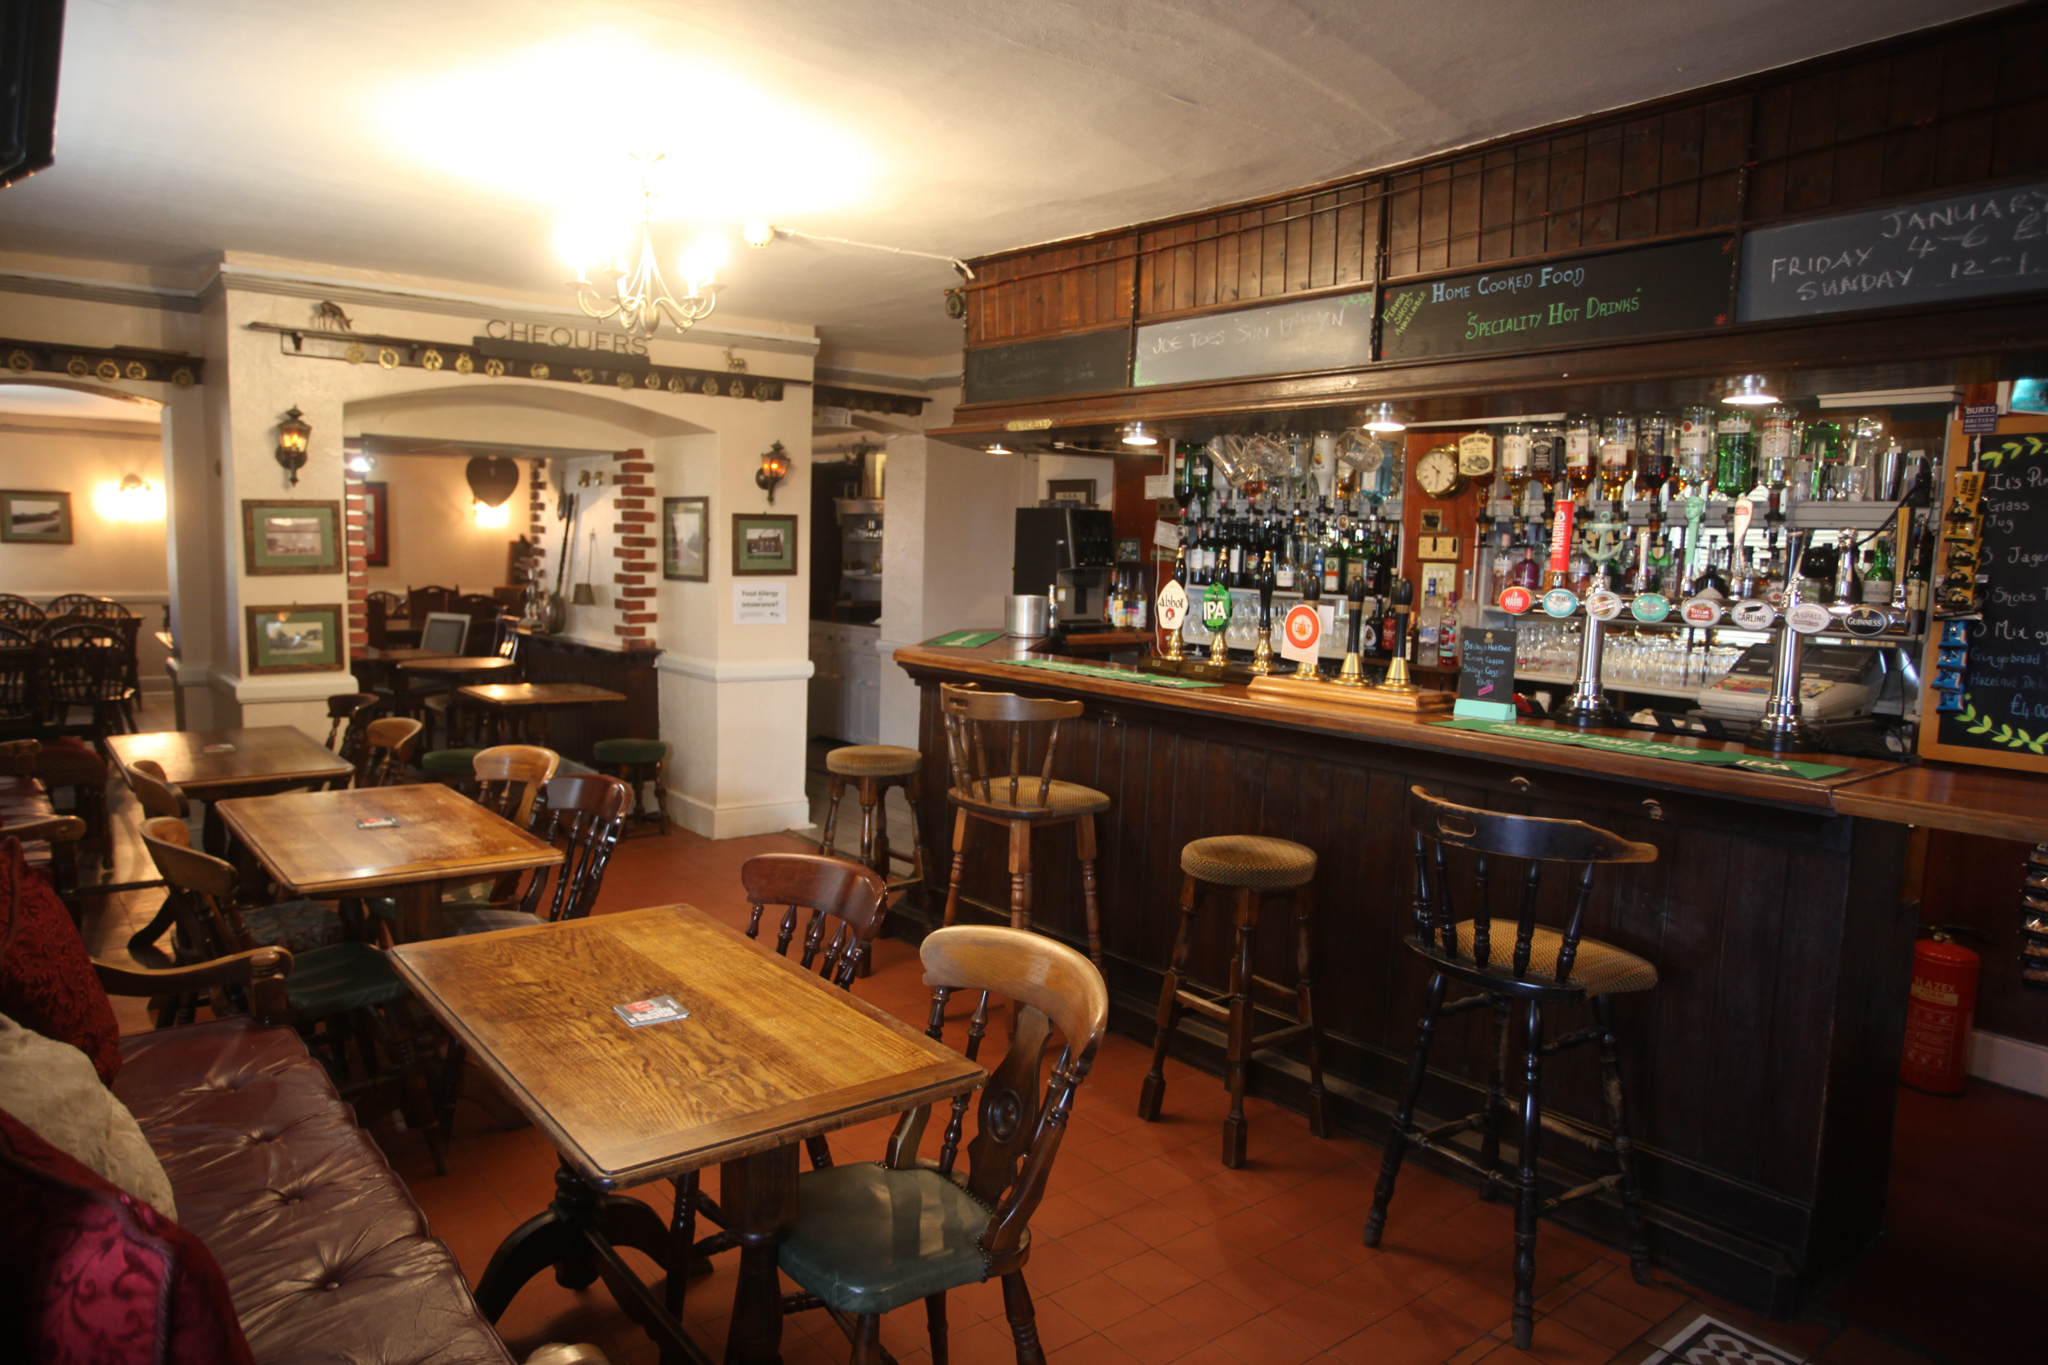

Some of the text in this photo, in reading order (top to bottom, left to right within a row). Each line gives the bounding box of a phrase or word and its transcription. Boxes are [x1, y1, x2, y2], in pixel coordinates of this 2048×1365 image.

[1771, 247, 1873, 284] FRIDAY
[1431, 267, 1585, 304] HOME COOKED FOOD
[1797, 266, 1915, 301] SUNDAY
[1465, 296, 1640, 340] SPECIALITY HOT DRINKS
[486, 319, 648, 357] CHEQUERS
[1965, 405, 1996, 415] BURTS
[1988, 473, 2022, 491] It's
[1986, 498, 2030, 512] Glass
[1985, 514, 2015, 533] Jug
[758, 590, 779, 598] Allergy
[1158, 595, 1185, 609] Abbot
[1992, 586, 2037, 607] Shots
[1203, 600, 1228, 621] IPA
[1738, 612, 1767, 623] CARLING
[1793, 611, 1822, 620] ASPALL
[1847, 616, 1882, 627] GUINNESS
[1994, 620, 2029, 640] Mix
[1970, 646, 2040, 669] Gingerbread
[1970, 671, 2018, 688] Hazelnut
[1914, 975, 1956, 994] BLAZEX
[1919, 988, 1945, 999] FOAM
